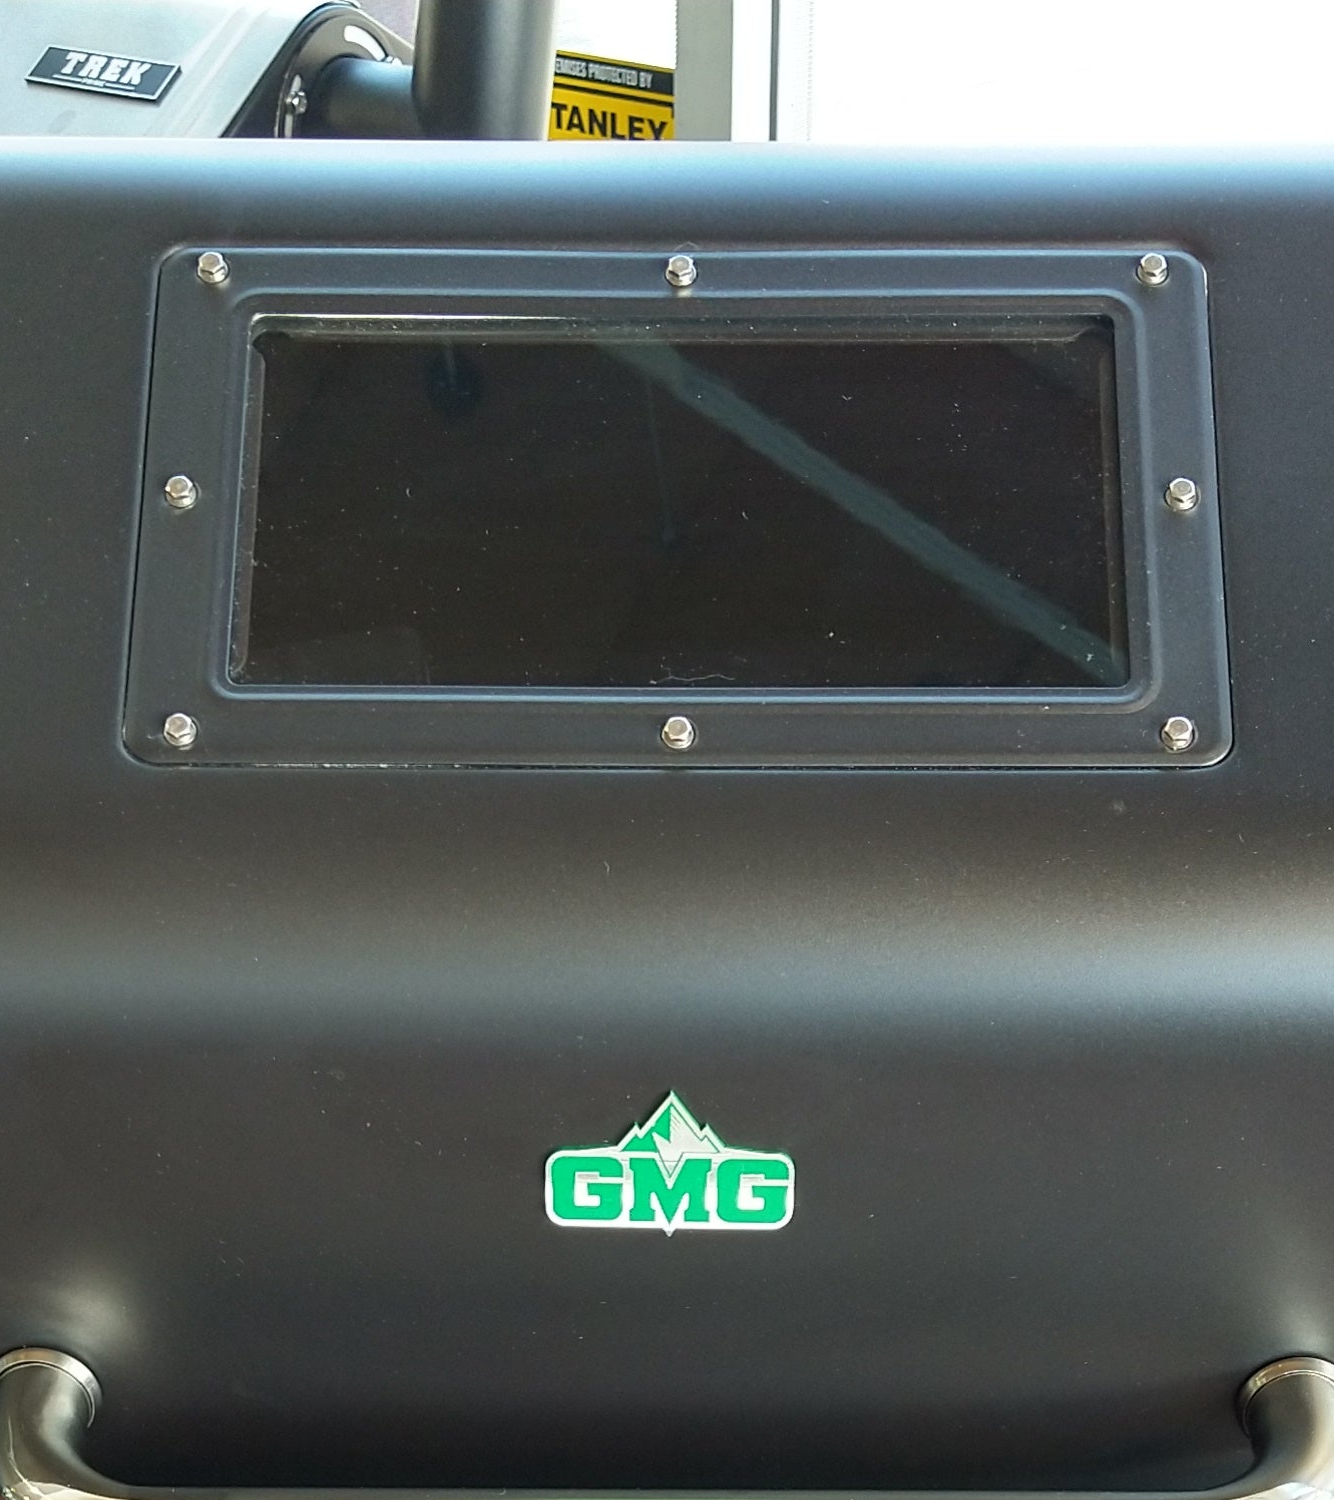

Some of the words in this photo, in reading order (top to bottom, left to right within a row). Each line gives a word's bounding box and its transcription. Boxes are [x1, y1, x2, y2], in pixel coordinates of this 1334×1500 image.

[60, 51, 151, 85] TREK
[555, 57, 587, 78] EMISES
[639, 71, 654, 88] BY
[551, 102, 667, 141] TANLEY
[549, 1155, 790, 1224] GMG
